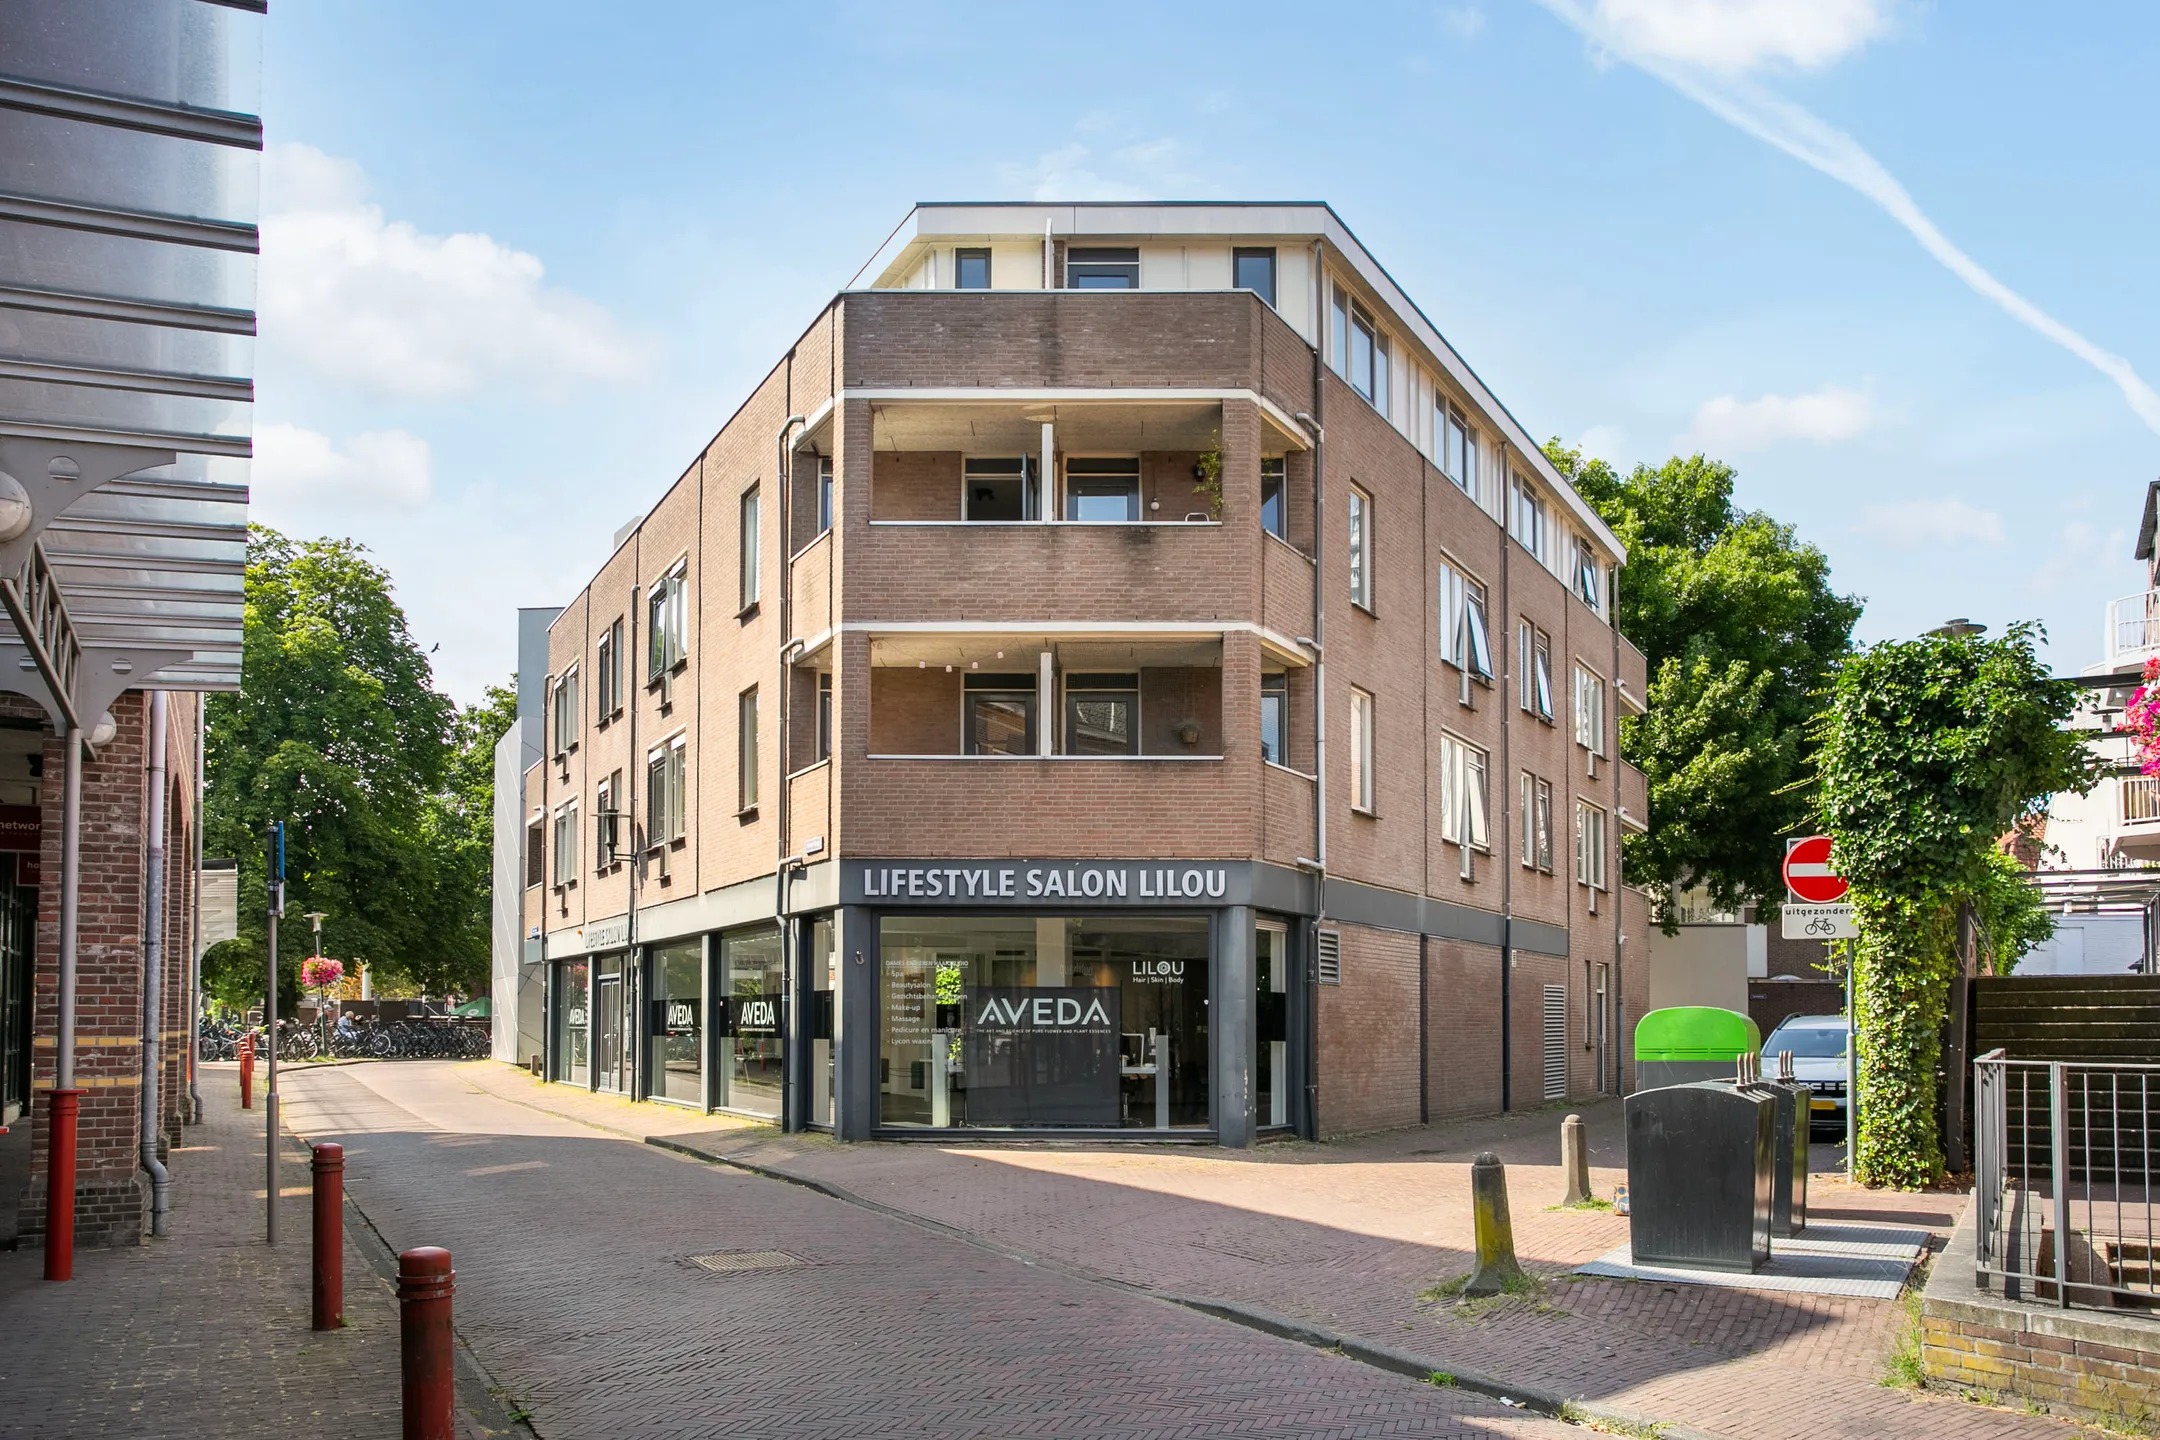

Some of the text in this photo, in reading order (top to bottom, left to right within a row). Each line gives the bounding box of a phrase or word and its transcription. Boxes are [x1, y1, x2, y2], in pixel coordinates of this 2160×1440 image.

[864, 868, 1226, 898] LIFESTYLE SALON LILOU
[1132, 960, 1185, 975] LILOU
[891, 970, 904, 978] Spa
[1168, 976, 1184, 984] Body
[891, 981, 932, 990] Beautysalon
[740, 1000, 776, 1025] AVEDA
[891, 1004, 921, 1012] Make-up
[977, 997, 1111, 1025] AVEDA
[569, 1008, 585, 1025] AVEDA
[667, 1004, 693, 1025] AVEDA
[891, 1015, 920, 1024] Massage
[891, 1026, 920, 1034] Pedicure
[930, 1026, 962, 1034] manicure
[891, 1038, 911, 1046] Lycon
